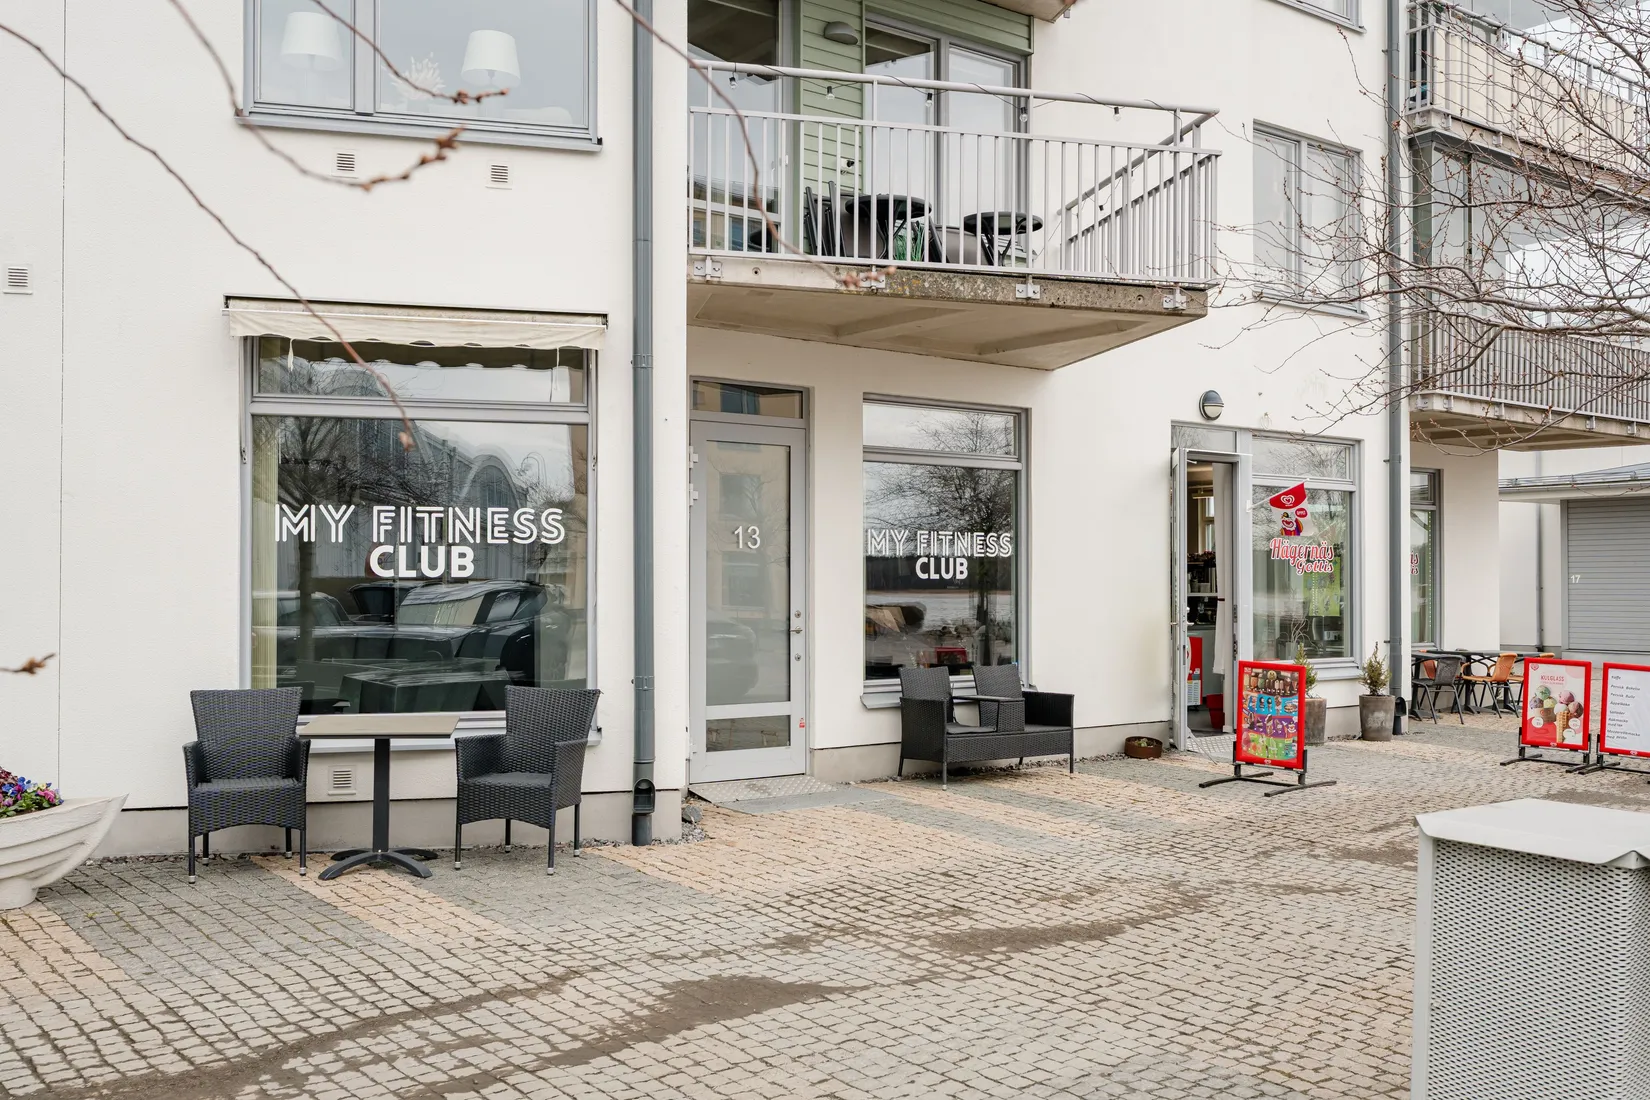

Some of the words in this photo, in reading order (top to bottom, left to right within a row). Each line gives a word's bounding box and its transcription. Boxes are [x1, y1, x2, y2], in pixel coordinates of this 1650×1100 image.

[275, 504, 355, 543] MY
[373, 505, 565, 544] FITNESS
[734, 526, 761, 549] 13
[867, 528, 909, 556] MY
[917, 531, 1011, 558] FITNESS
[369, 545, 475, 578] CLUB
[1270, 538, 1334, 566] Hägernäs
[915, 557, 968, 580] CLUB
[1295, 559, 1334, 575] Gottis
[1571, 574, 1581, 584] 17
